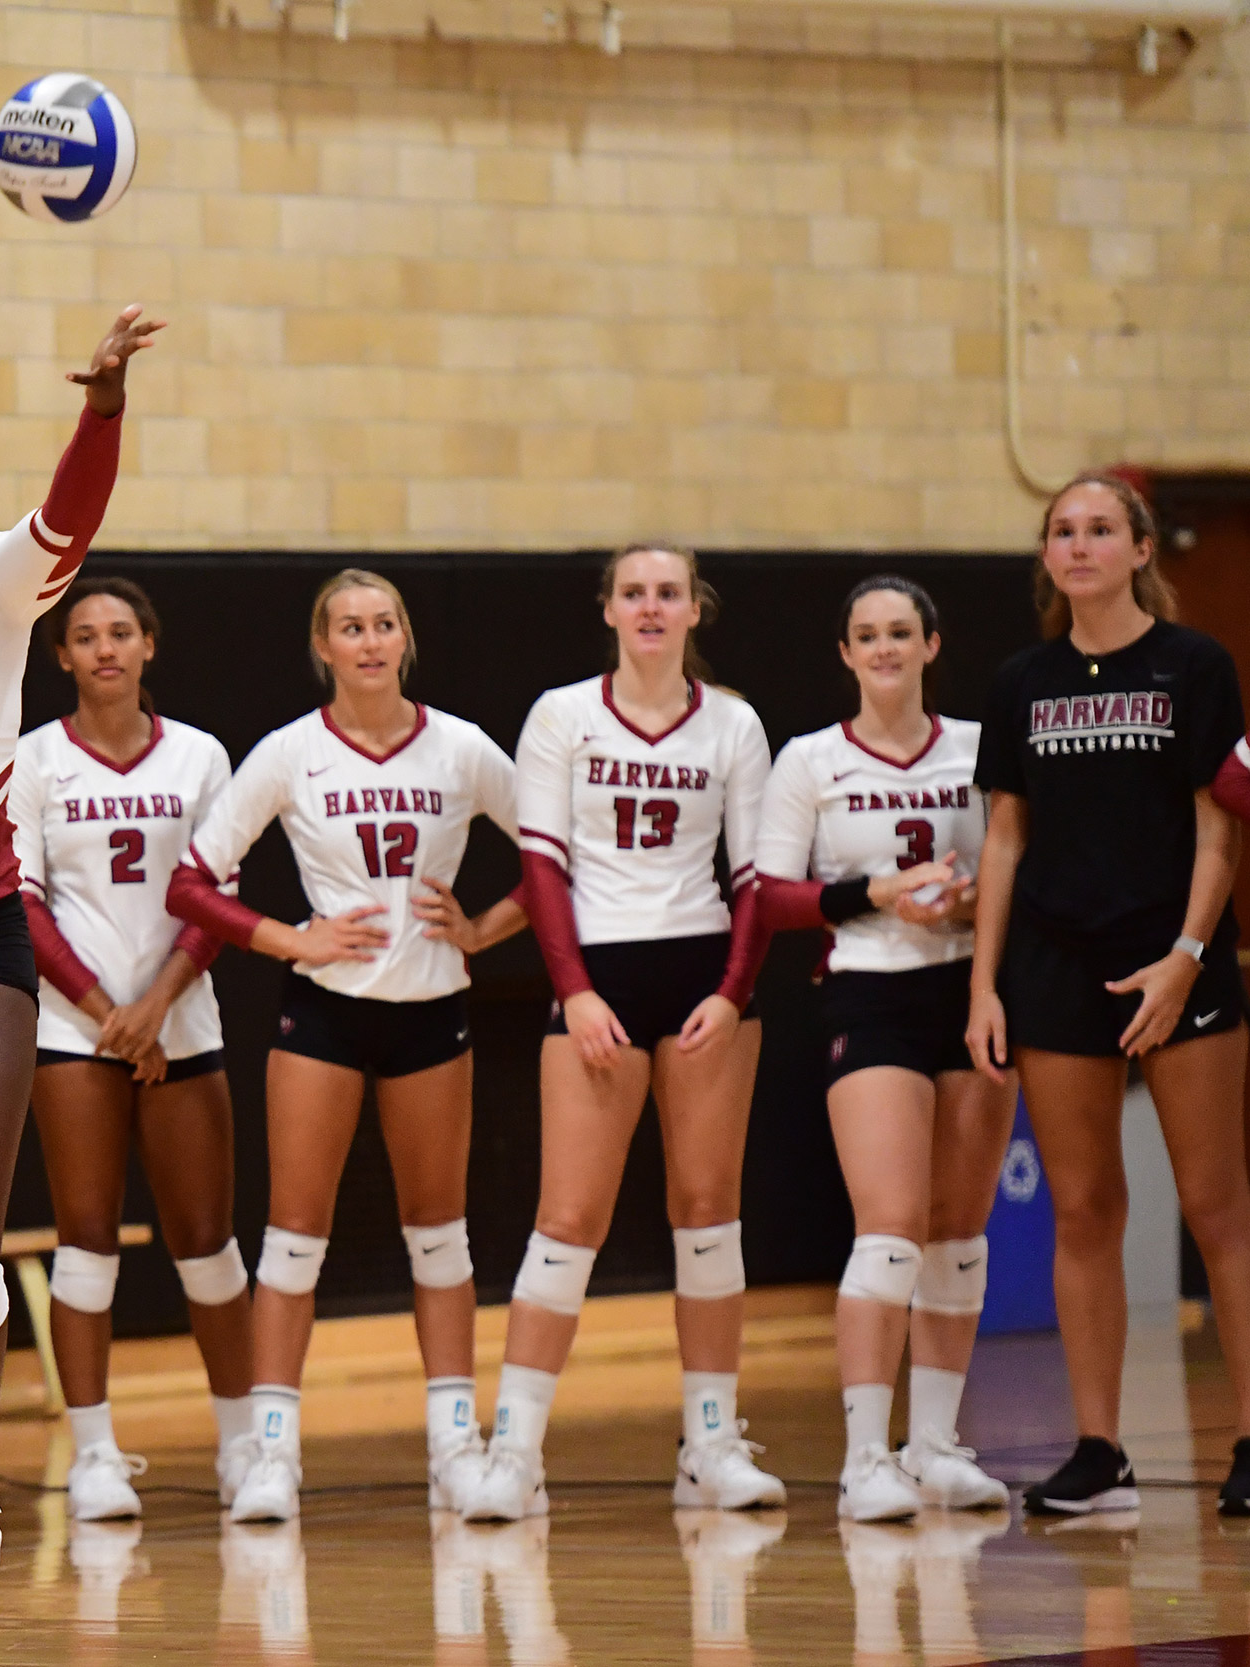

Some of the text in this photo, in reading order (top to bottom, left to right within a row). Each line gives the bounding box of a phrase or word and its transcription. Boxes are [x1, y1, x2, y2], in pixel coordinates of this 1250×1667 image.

[2, 134, 60, 165] NCAA
[1031, 691, 1173, 733] HARVARD
[1036, 735, 1161, 757] VOLLEYBALL
[588, 757, 709, 790] HARVARD
[65, 794, 182, 823] HARVARD
[324, 787, 442, 818] HARVARD
[614, 797, 680, 849] 13
[109, 828, 146, 884] 2
[356, 822, 419, 878] 12
[895, 819, 935, 871] 3
